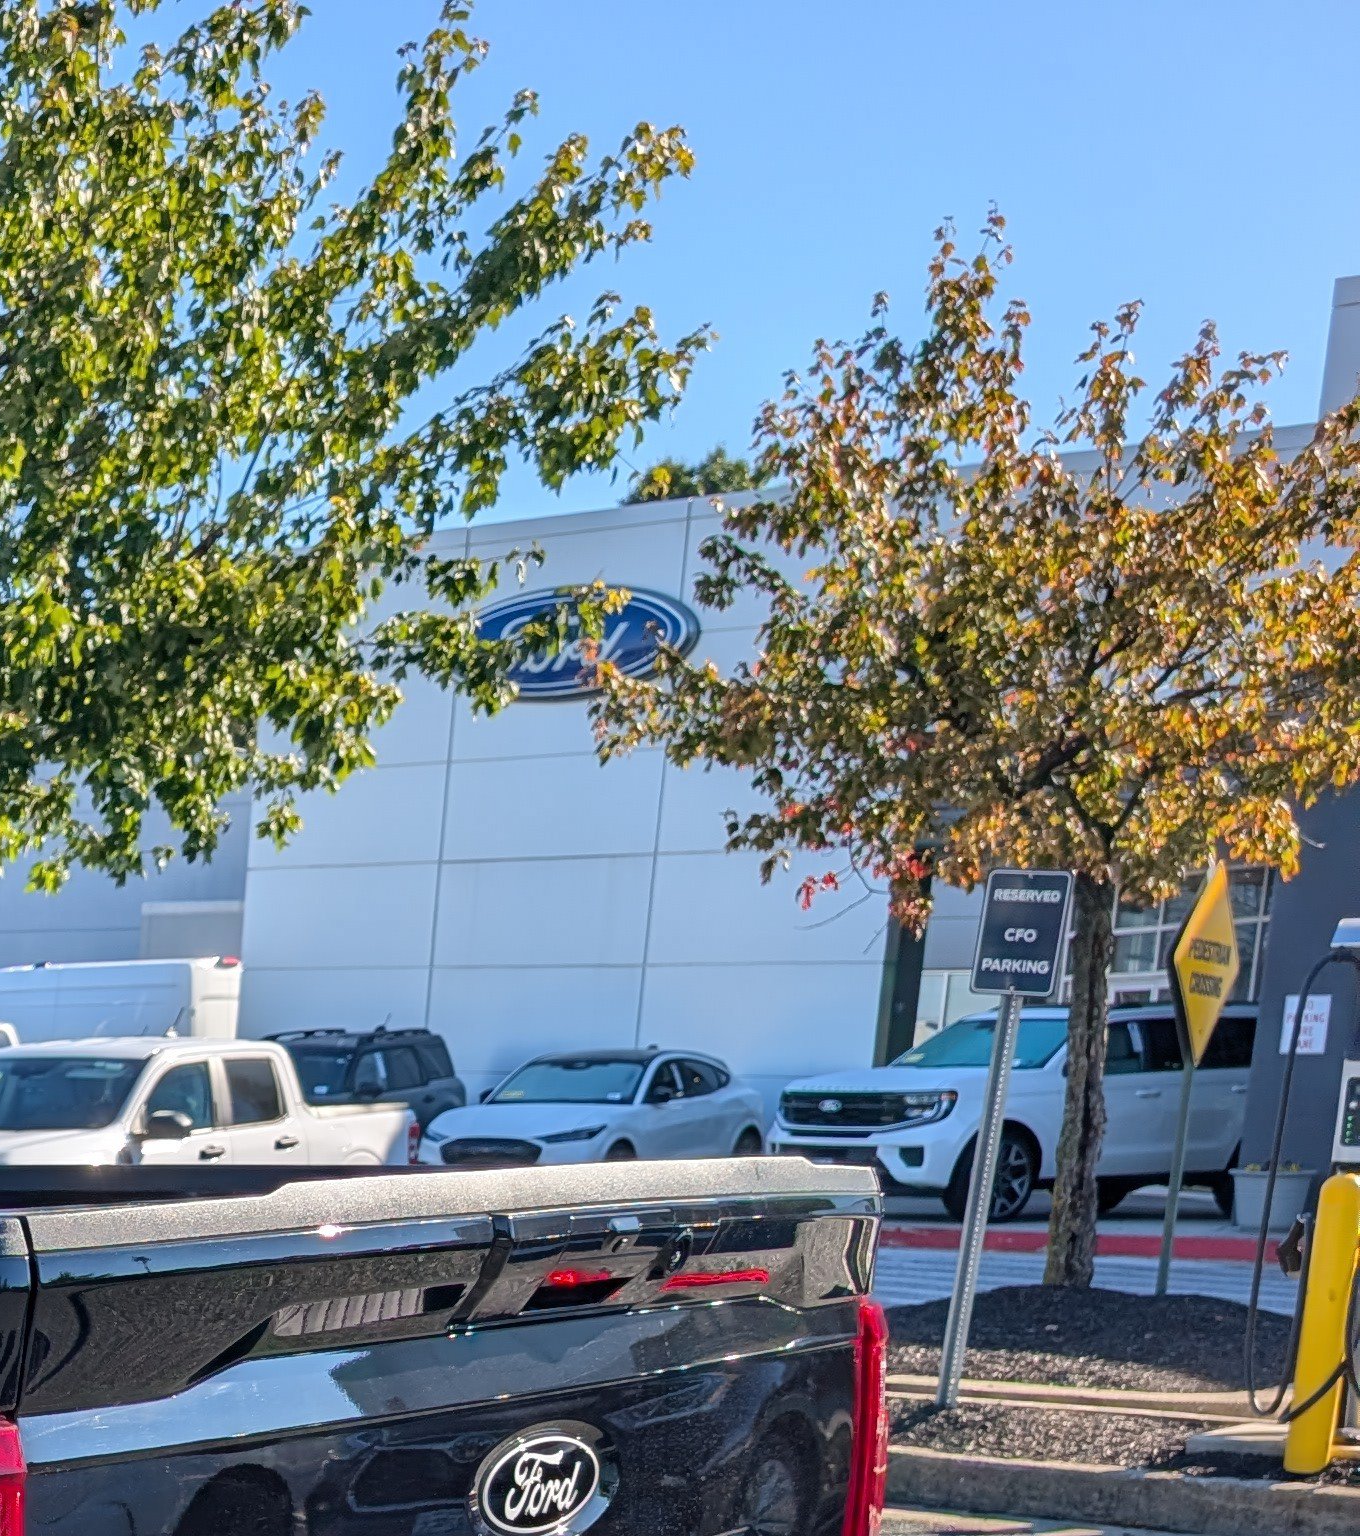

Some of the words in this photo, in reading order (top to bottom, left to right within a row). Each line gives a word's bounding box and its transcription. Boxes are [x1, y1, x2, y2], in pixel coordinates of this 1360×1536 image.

[993, 888, 1062, 903] RESERVED
[1004, 928, 1037, 943] CFO
[981, 957, 1050, 975] PARKING
[1286, 1012, 1326, 1023] PKING
[502, 1447, 583, 1522] Ford
